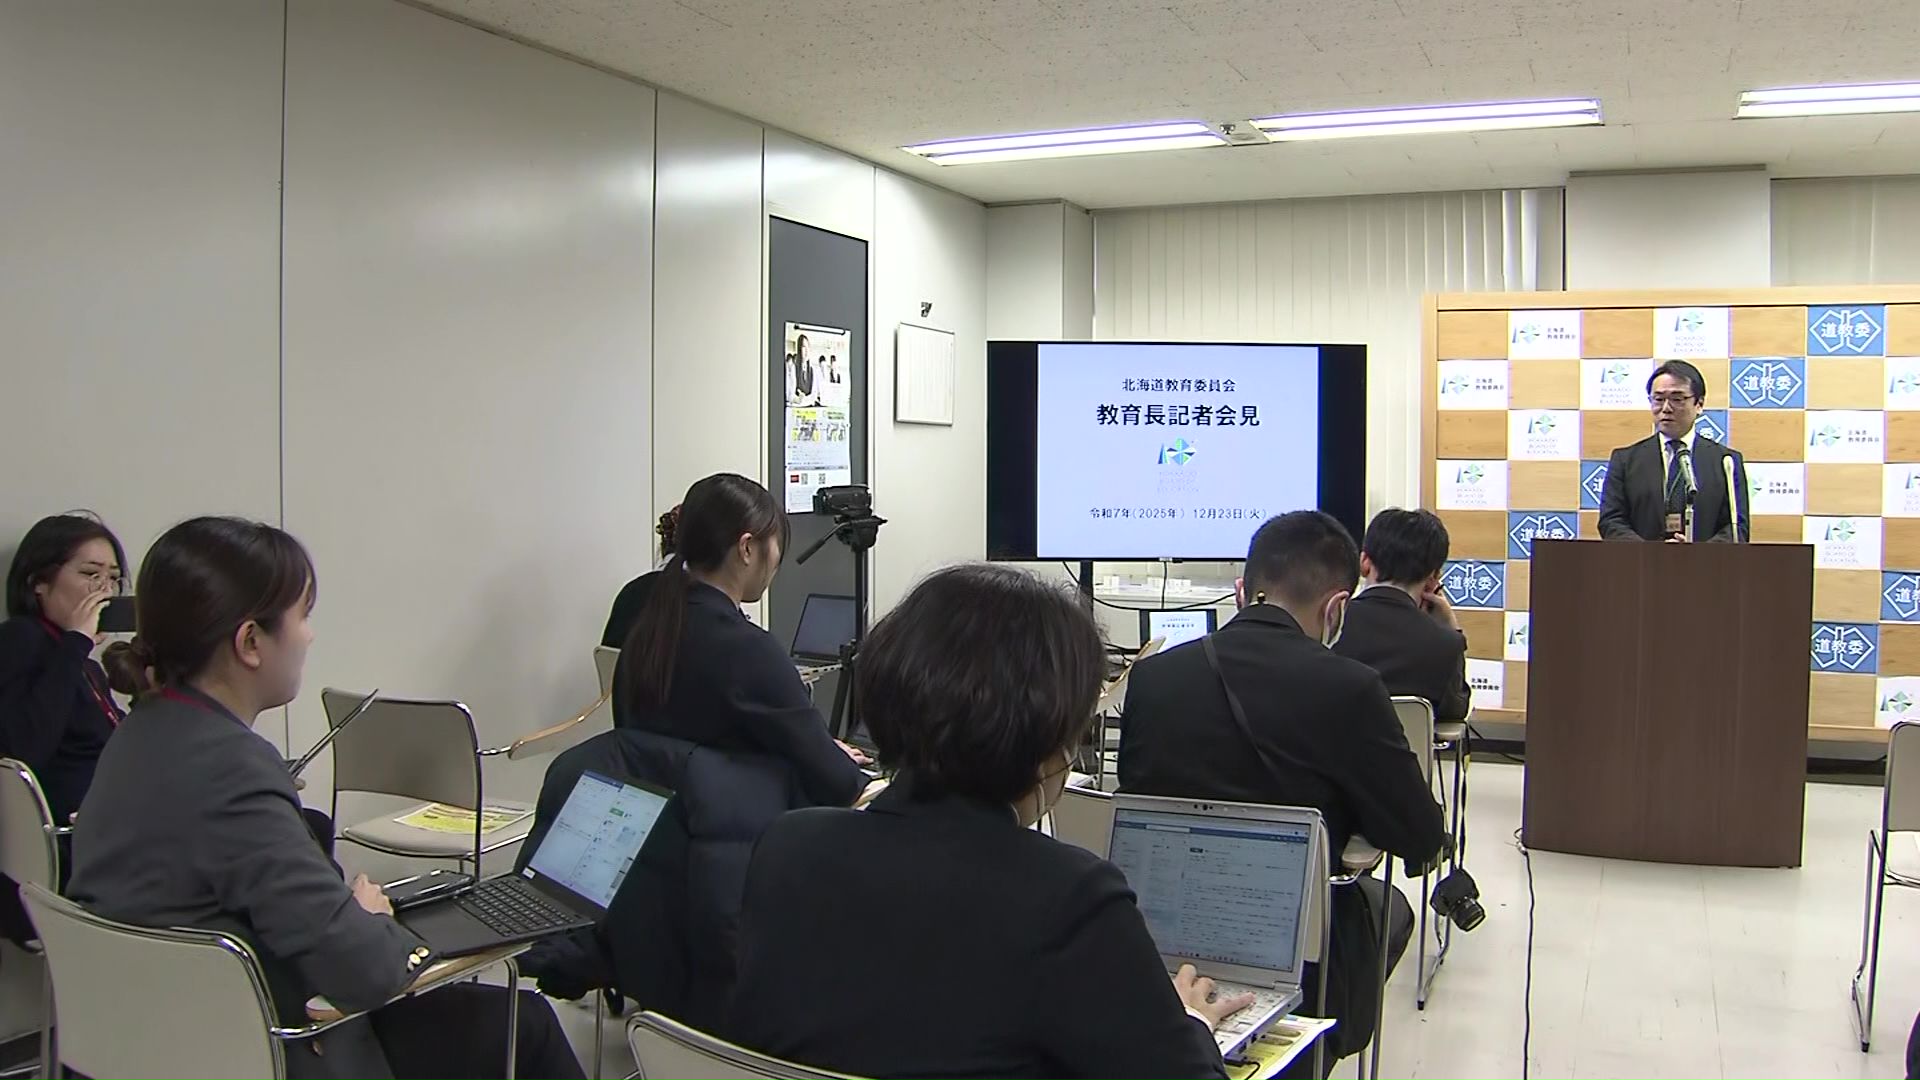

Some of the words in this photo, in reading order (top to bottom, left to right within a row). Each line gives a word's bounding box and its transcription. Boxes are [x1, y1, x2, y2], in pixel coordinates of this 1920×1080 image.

[1821, 322, 1870, 339] 道教委
[1122, 378, 1236, 392] 北海道教育委員会
[1743, 375, 1792, 392] 道教委
[1096, 404, 1260, 426] 教育長記者会見
[1448, 575, 1492, 591] 道教委
[1815, 638, 1864, 655] 道教委
